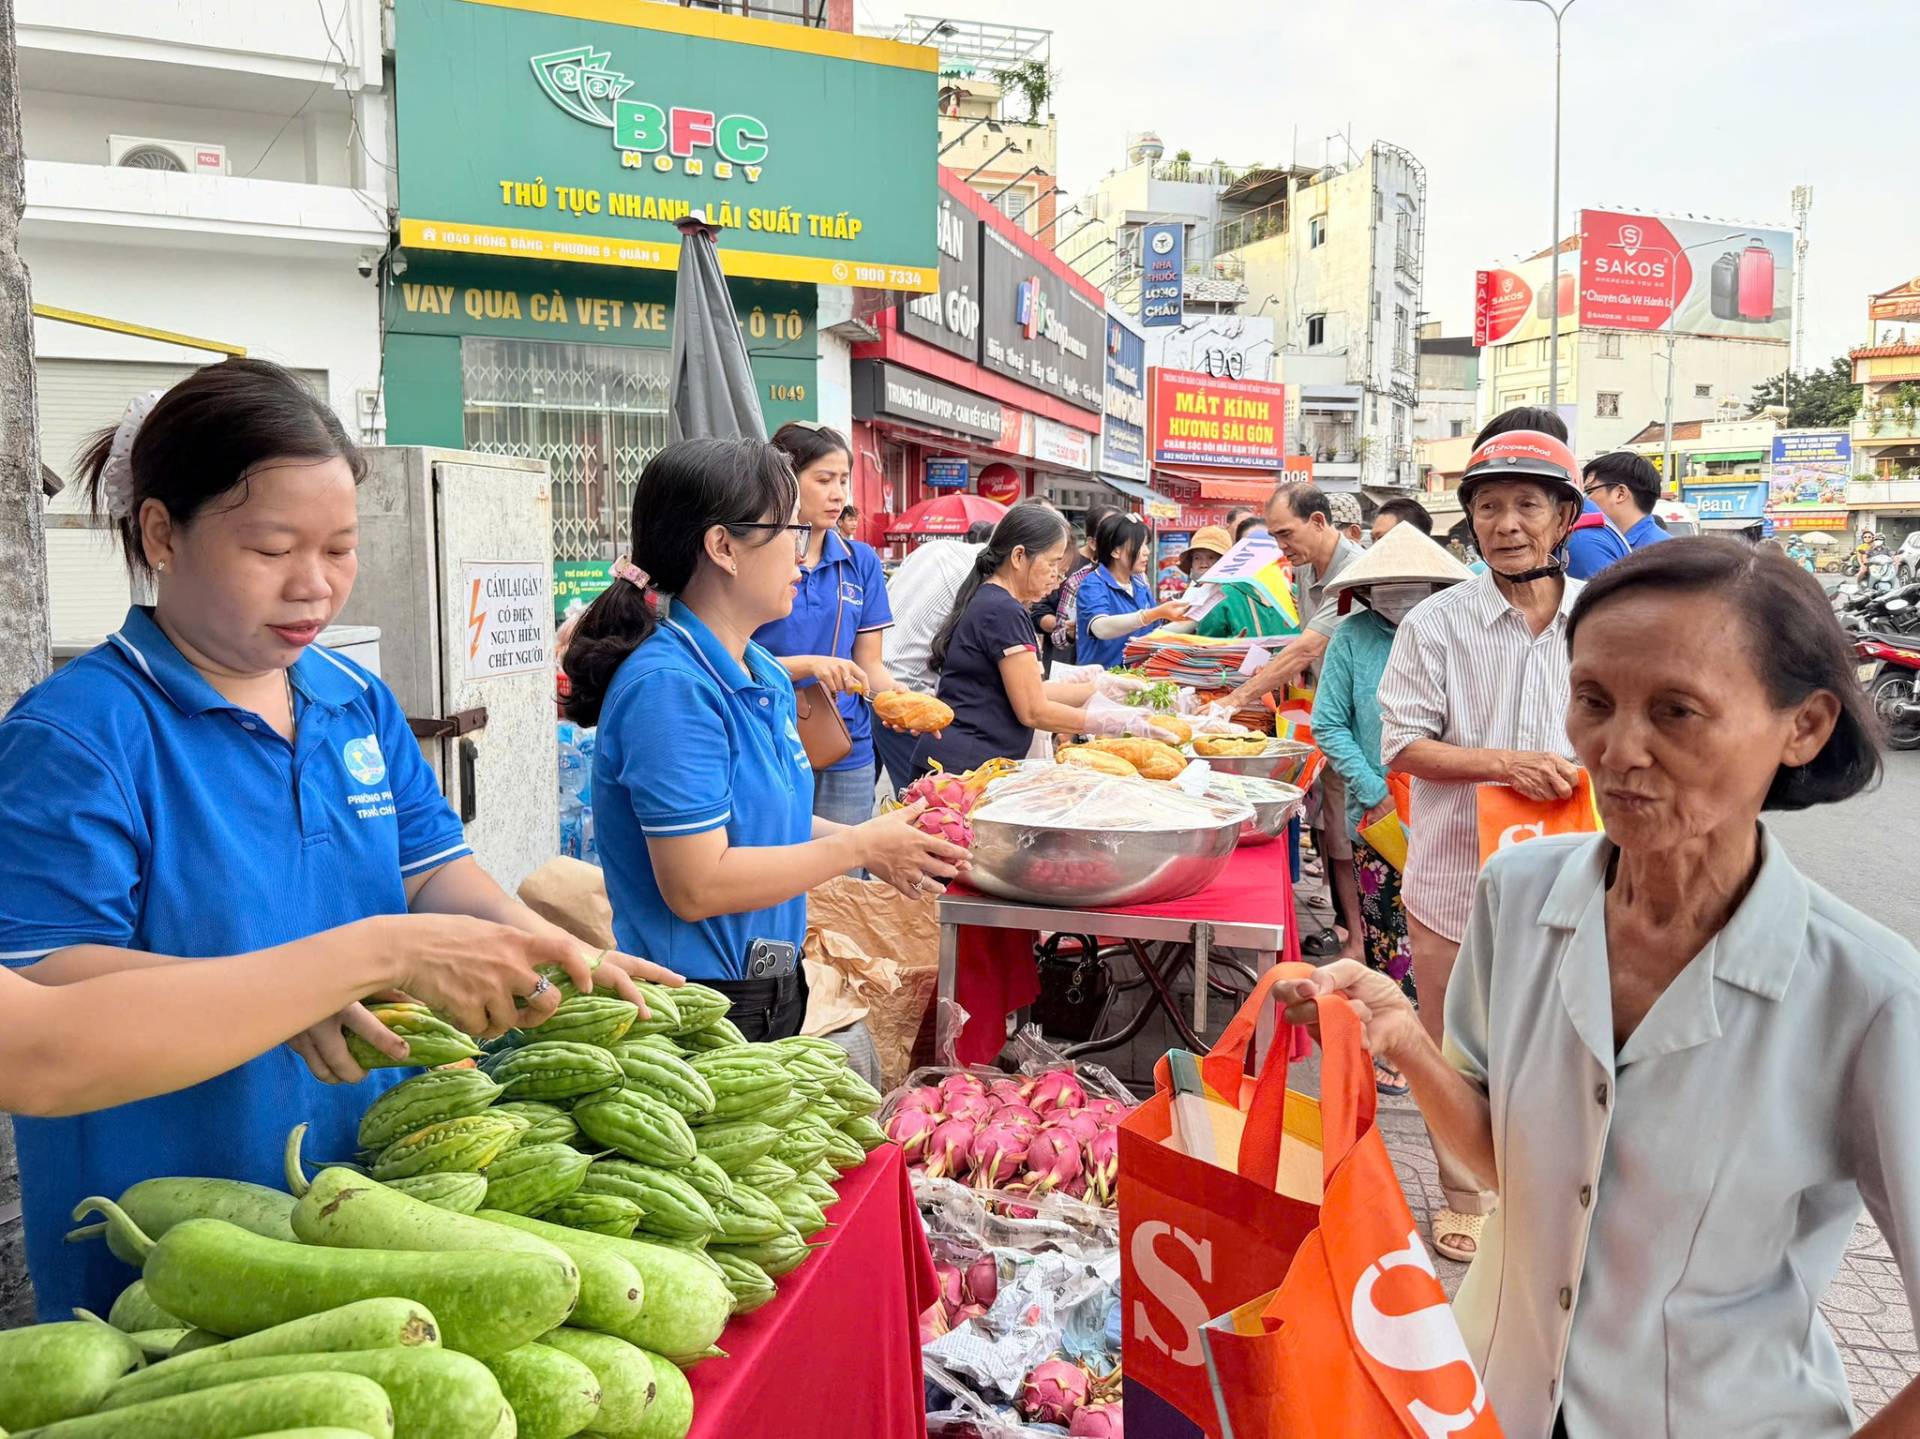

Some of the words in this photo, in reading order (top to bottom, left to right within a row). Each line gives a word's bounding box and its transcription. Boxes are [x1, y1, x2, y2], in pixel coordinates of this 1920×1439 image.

[614, 99, 768, 165] BFC
[200, 155, 217, 164] TCL
[622, 150, 763, 183] MONEY
[500, 176, 548, 209] THỦ
[555, 186, 600, 218] TỤC
[608, 192, 690, 222] NHANH
[705, 200, 742, 229] LÃI
[748, 205, 802, 235] SUẤT
[808, 211, 863, 240] THẤP
[442, 231, 470, 245] 1049
[855, 266, 885, 282] 1900
[889, 269, 922, 286] 7334
[1595, 258, 1665, 278] SAKOS
[1145, 286, 1179, 299] LONG
[403, 283, 455, 315] VAY
[464, 288, 522, 321] QUA
[530, 289, 569, 323] CÀ
[575, 296, 624, 332] VẸT
[632, 301, 667, 331] XE
[750, 304, 767, 339] Ô
[773, 307, 803, 341] TÔ
[945, 285, 980, 340] GÓP
[1476, 272, 1488, 342] SAKOS
[769, 384, 805, 402] 1049
[1175, 387, 1220, 416] MẮT
[1223, 395, 1270, 421] KÍNH
[1496, 444, 1552, 457] ShopeeFood
[1695, 494, 1734, 512] Jean
[1737, 494, 1748, 511] 7
[486, 572, 506, 598] CẤM
[507, 578, 521, 601] LẠI
[498, 604, 512, 623] CÓ
[513, 606, 534, 625] ĐIỆN
[491, 629, 517, 645] NGUY
[488, 649, 514, 668] CHẾT
[1131, 1220, 1212, 1367] S
[1351, 1229, 1486, 1439] S
